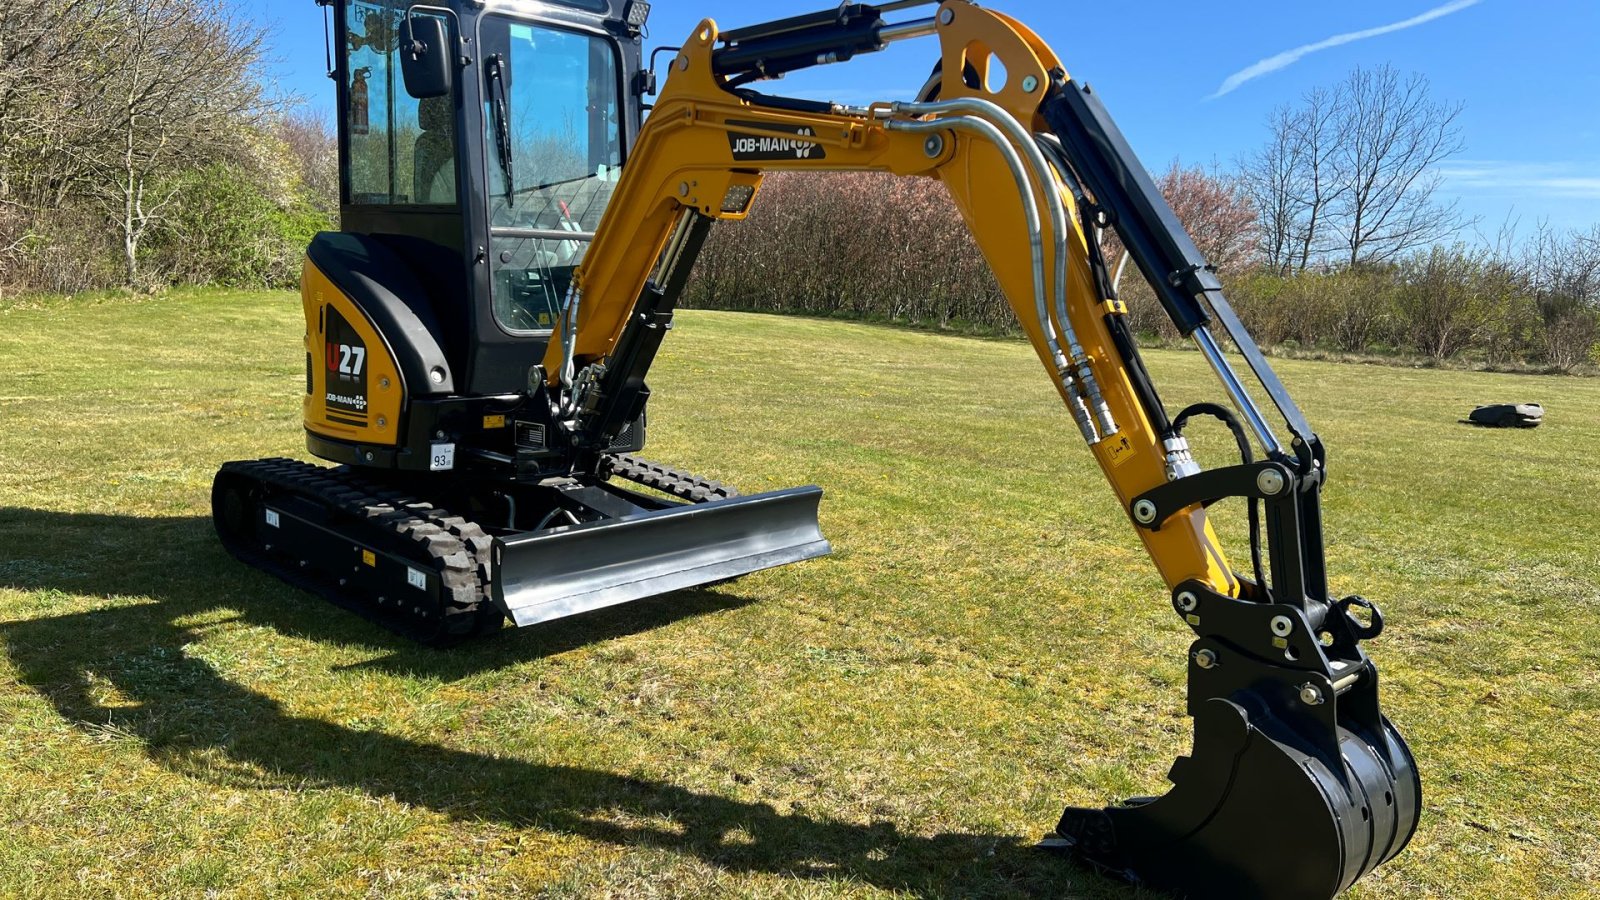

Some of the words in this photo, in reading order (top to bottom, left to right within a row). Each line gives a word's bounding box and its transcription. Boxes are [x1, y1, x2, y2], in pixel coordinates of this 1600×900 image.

[733, 137, 790, 153] JOB-MAN
[326, 342, 365, 376] U27
[326, 393, 353, 405] JOB-MAN
[434, 454, 446, 467] 93
